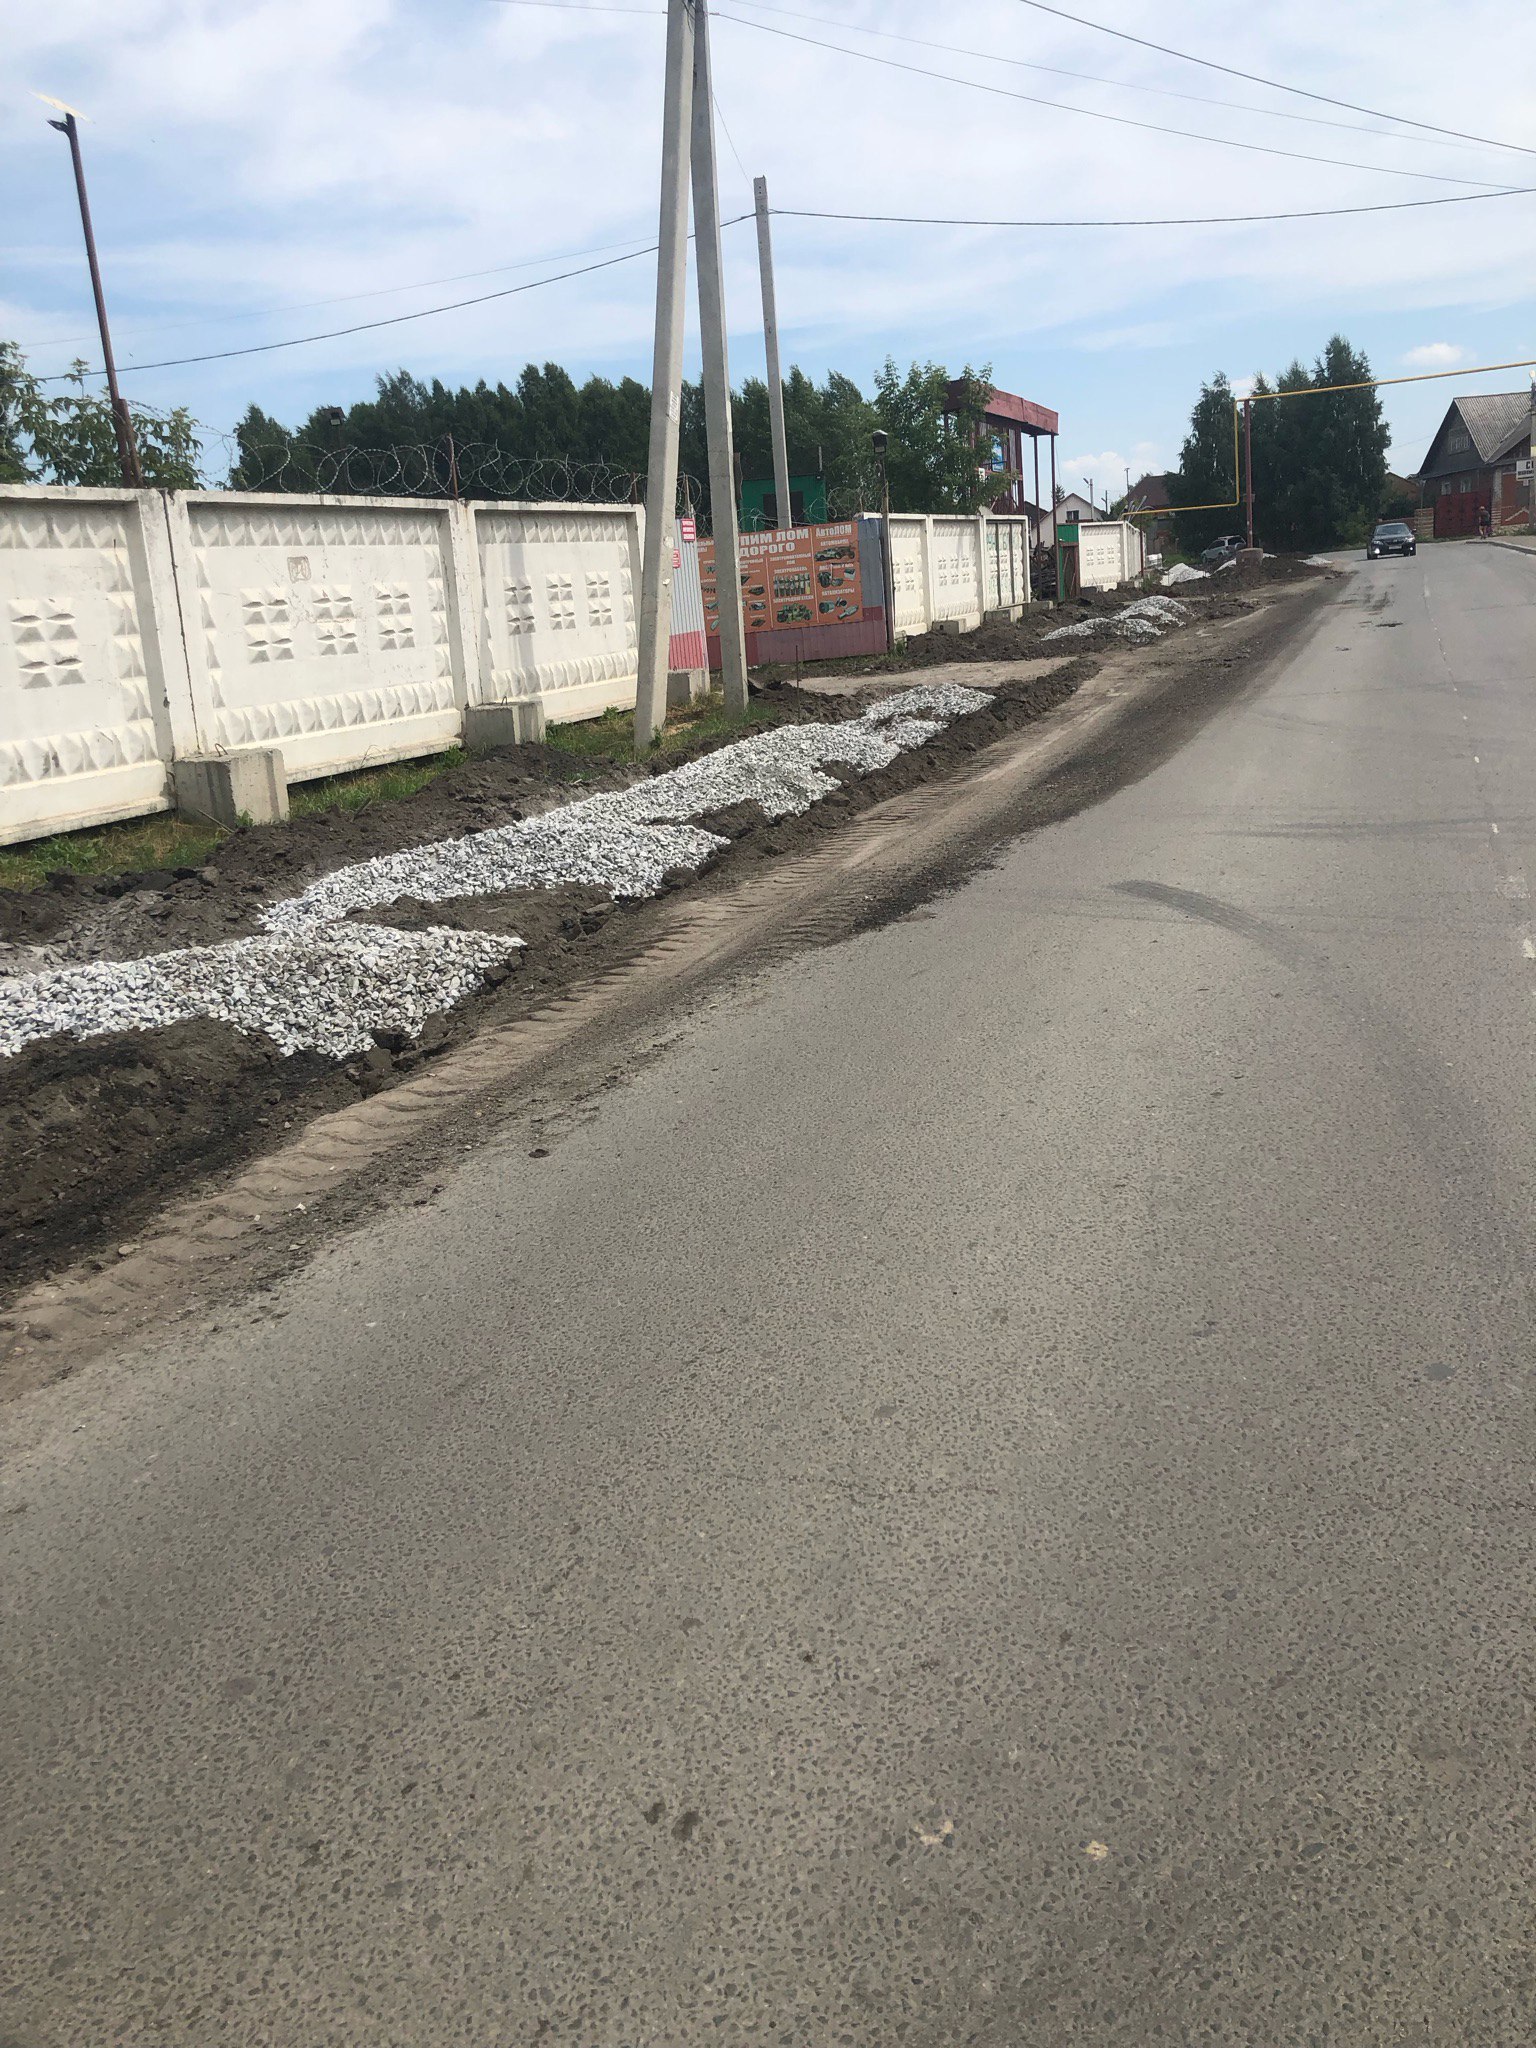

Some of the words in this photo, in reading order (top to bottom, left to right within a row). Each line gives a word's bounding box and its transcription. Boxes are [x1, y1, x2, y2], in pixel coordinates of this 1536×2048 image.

[741, 533, 772, 545] ПИМ
[776, 528, 809, 542] ЛОМ
[816, 524, 852, 537] АвтоЛОМ
[739, 542, 795, 558] ДОРОГО
